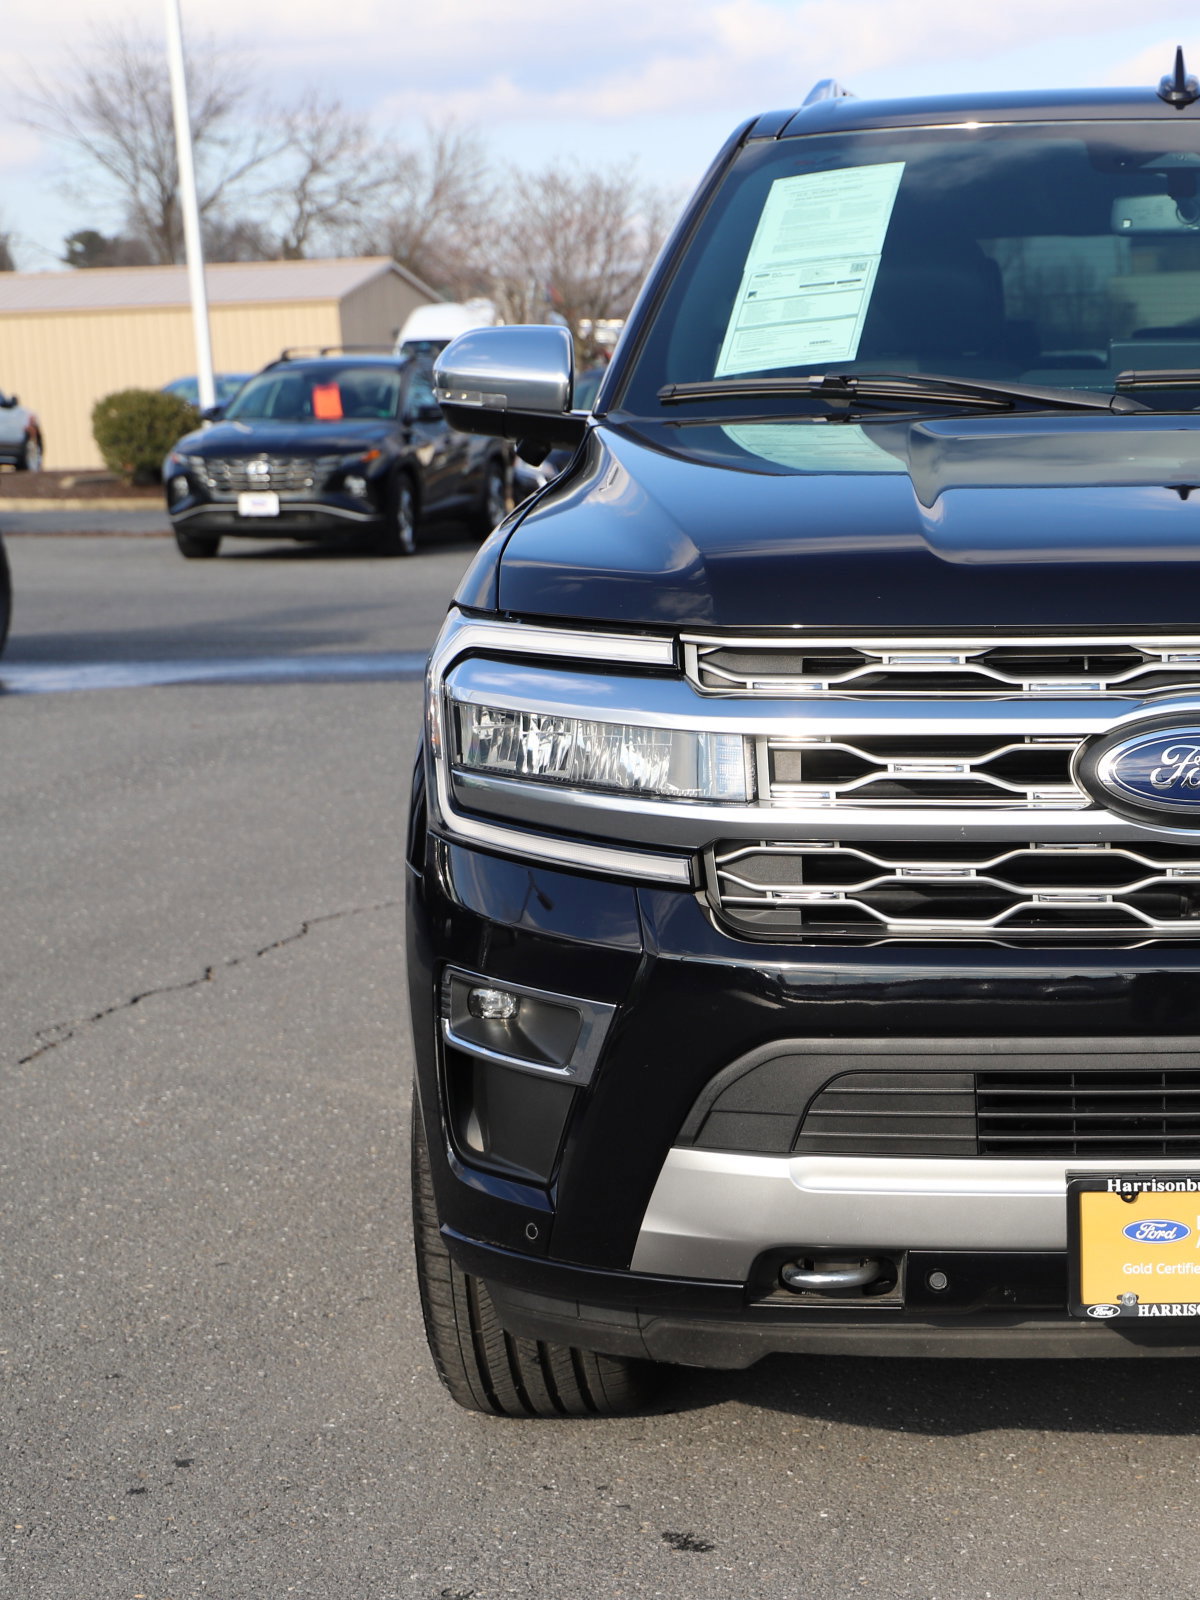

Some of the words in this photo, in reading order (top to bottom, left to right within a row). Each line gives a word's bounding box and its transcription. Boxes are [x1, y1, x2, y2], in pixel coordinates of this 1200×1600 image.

[1135, 1222, 1178, 1241] Ford
[1122, 1263, 1153, 1275] Gold
[1092, 1306, 1115, 1317] Ford
